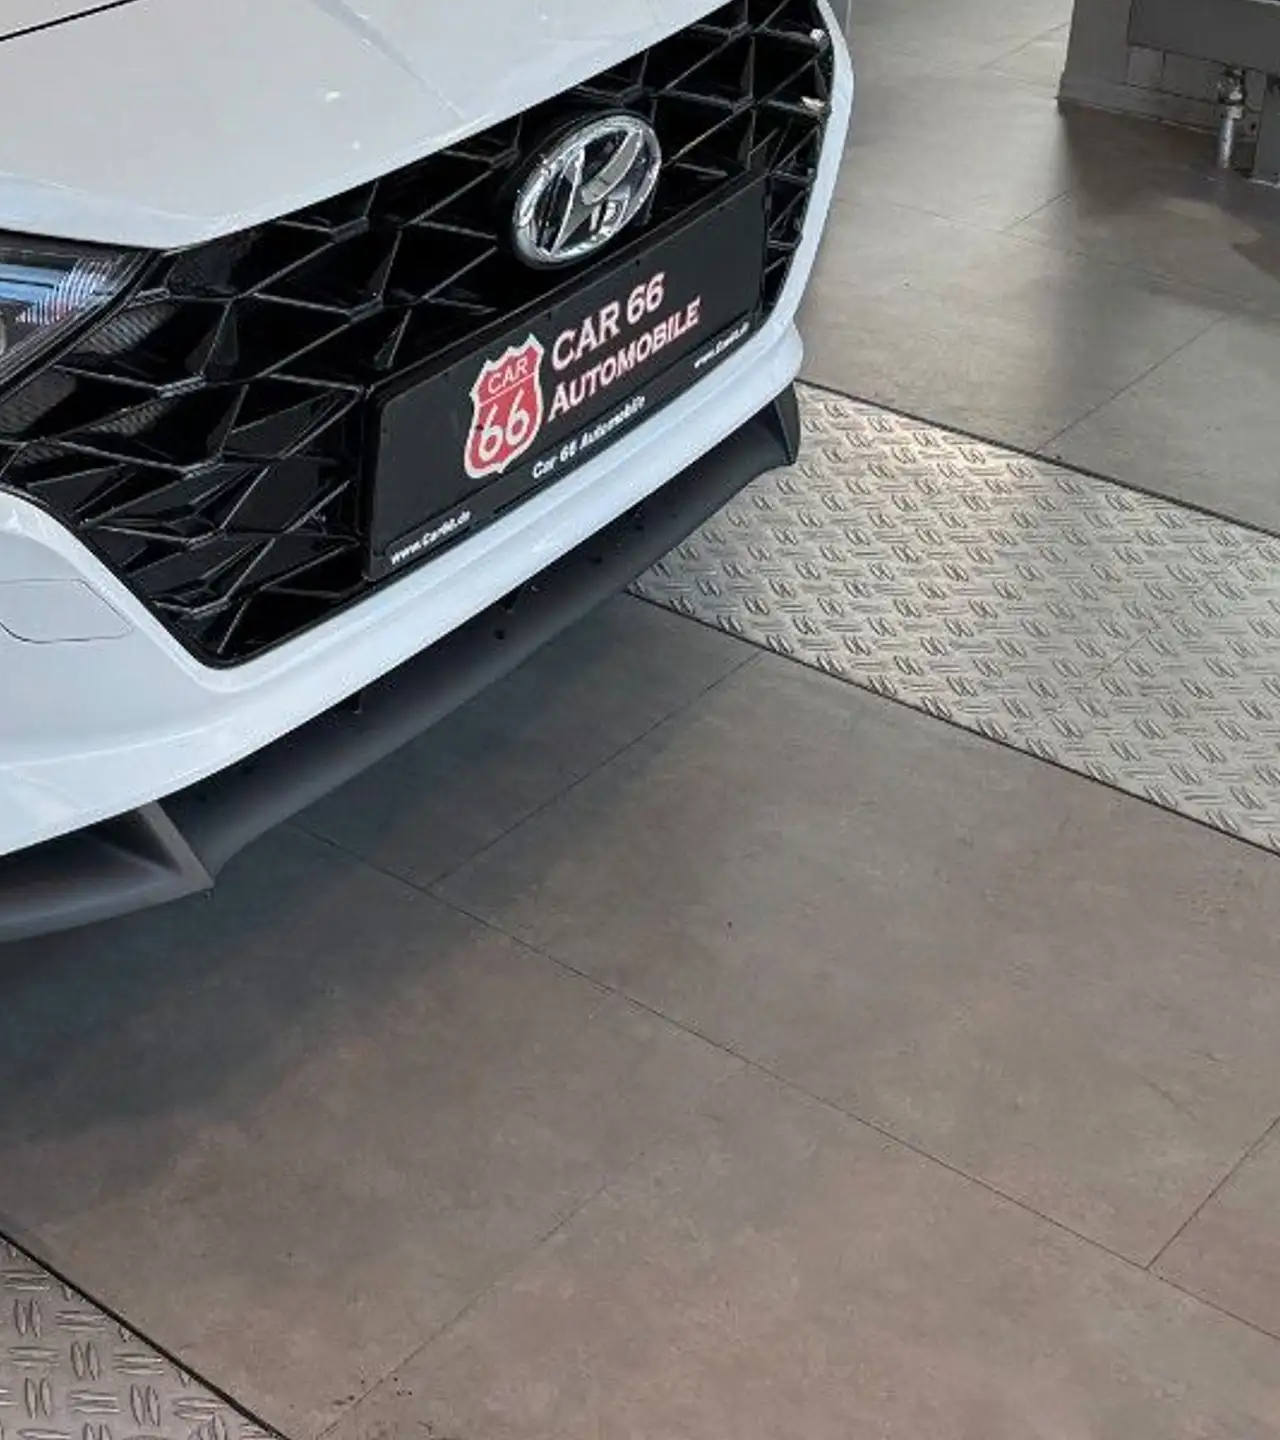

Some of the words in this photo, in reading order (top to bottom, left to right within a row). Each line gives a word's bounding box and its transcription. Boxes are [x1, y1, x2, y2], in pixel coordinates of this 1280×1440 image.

[552, 301, 622, 371] CAR
[626, 271, 666, 325] 66
[488, 358, 529, 395] CAR
[547, 296, 702, 422] AUTOMOBILE
[478, 389, 530, 462] 66
[532, 455, 559, 479] Car
